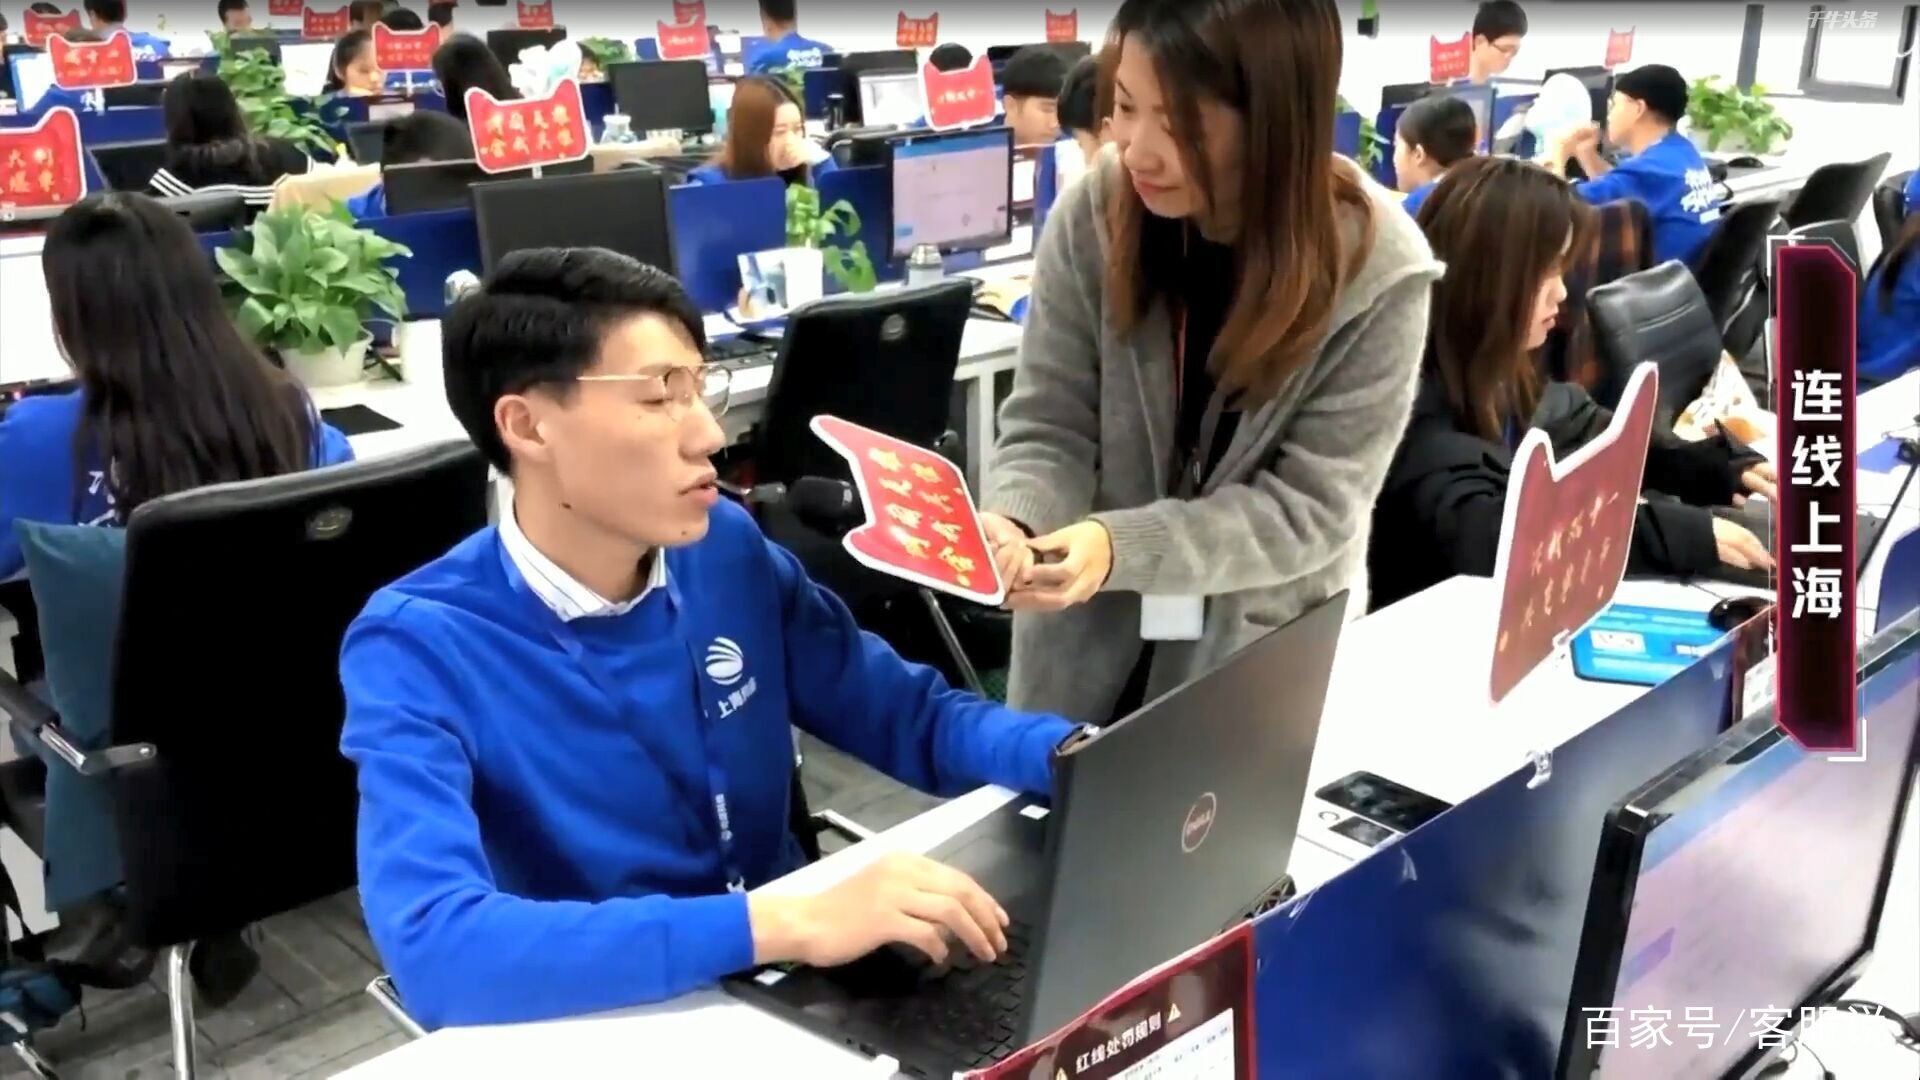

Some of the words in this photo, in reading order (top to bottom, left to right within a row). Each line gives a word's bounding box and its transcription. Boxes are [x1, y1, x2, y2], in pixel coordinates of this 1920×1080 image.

[1075, 1011, 1162, 1075] 红线处罚规则
